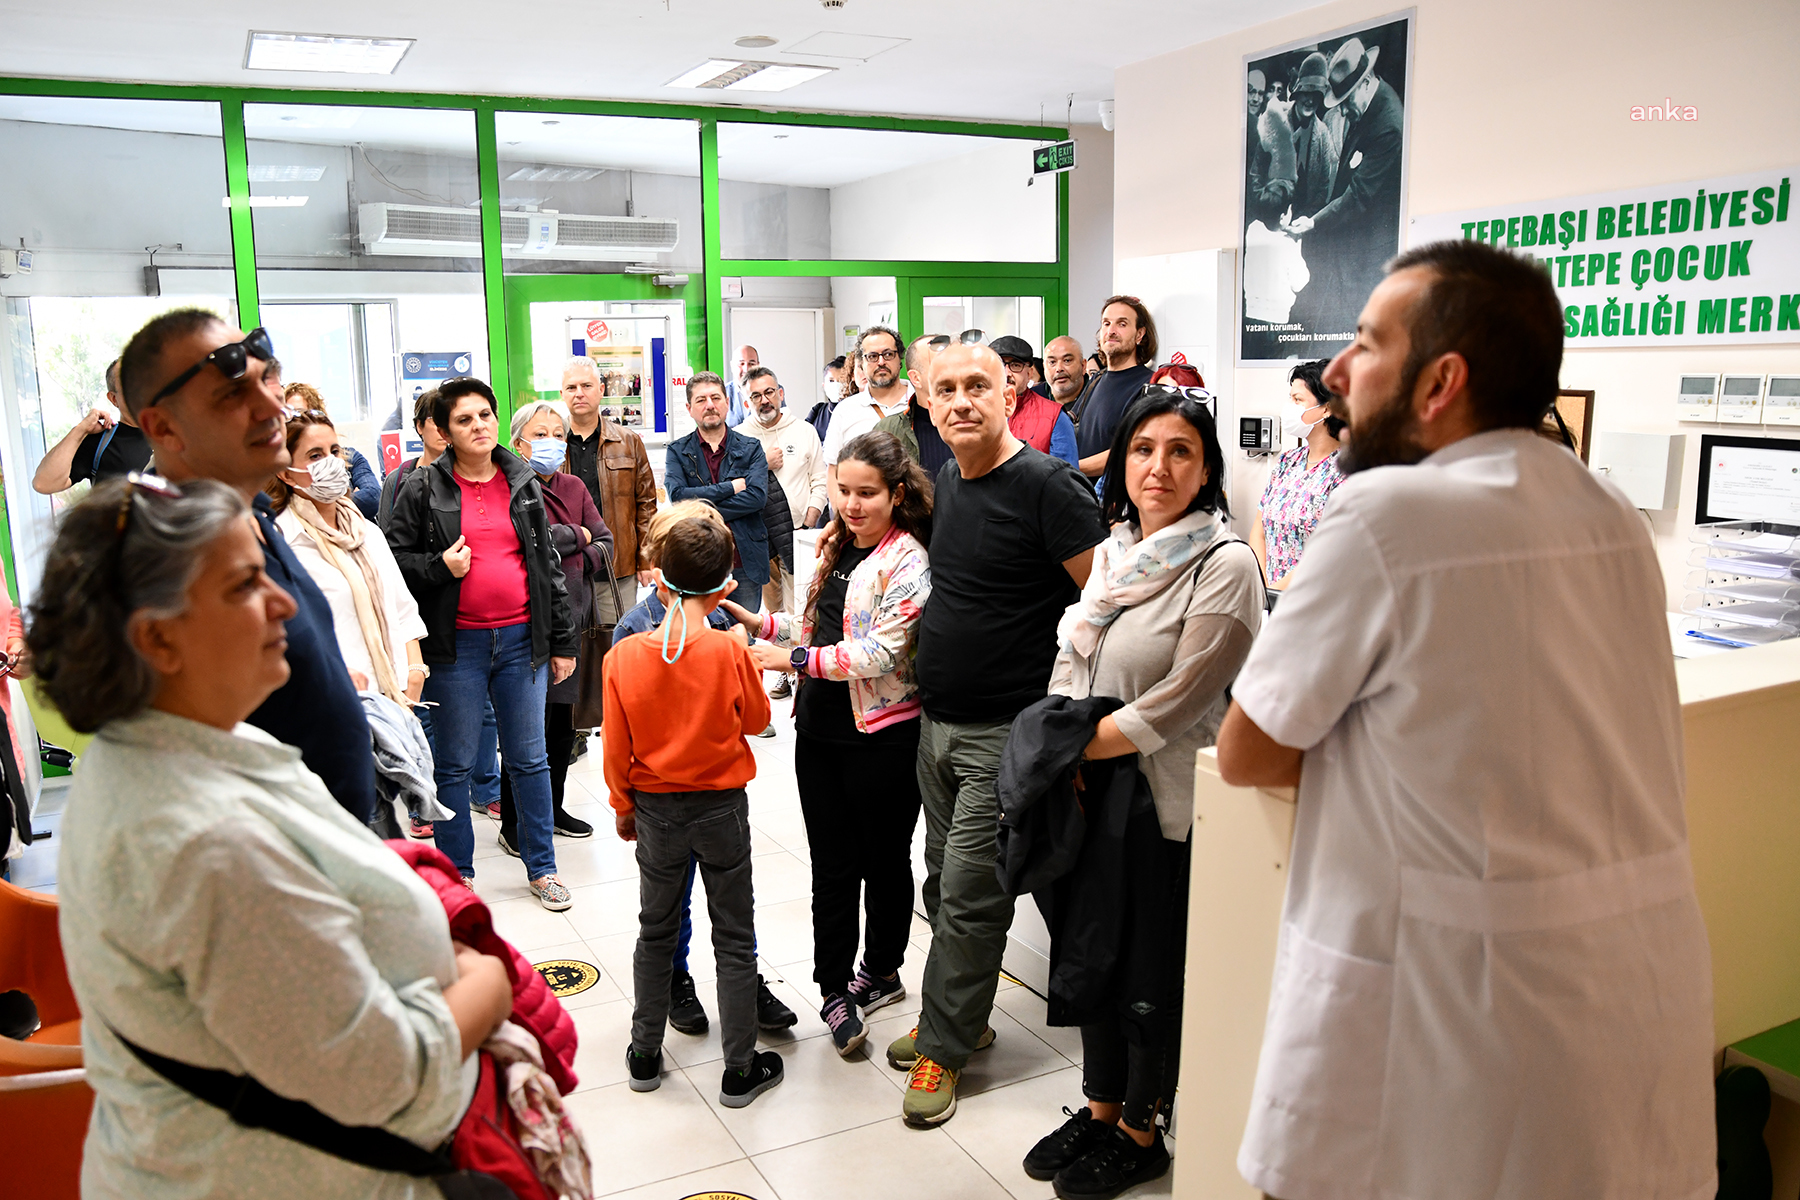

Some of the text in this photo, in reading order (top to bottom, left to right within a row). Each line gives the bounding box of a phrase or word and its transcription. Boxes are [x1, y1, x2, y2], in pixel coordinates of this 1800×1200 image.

[1058, 145, 1073, 157] EXIT
[1461, 177, 1791, 250] TEPEBAŞI BELEDİYESİ
[1630, 239, 1753, 291] ÇOCUK
[1270, 323, 1304, 332] korumak,
[1564, 294, 1686, 338] SAĞLIĞI
[1278, 333, 1311, 343] çocukları
